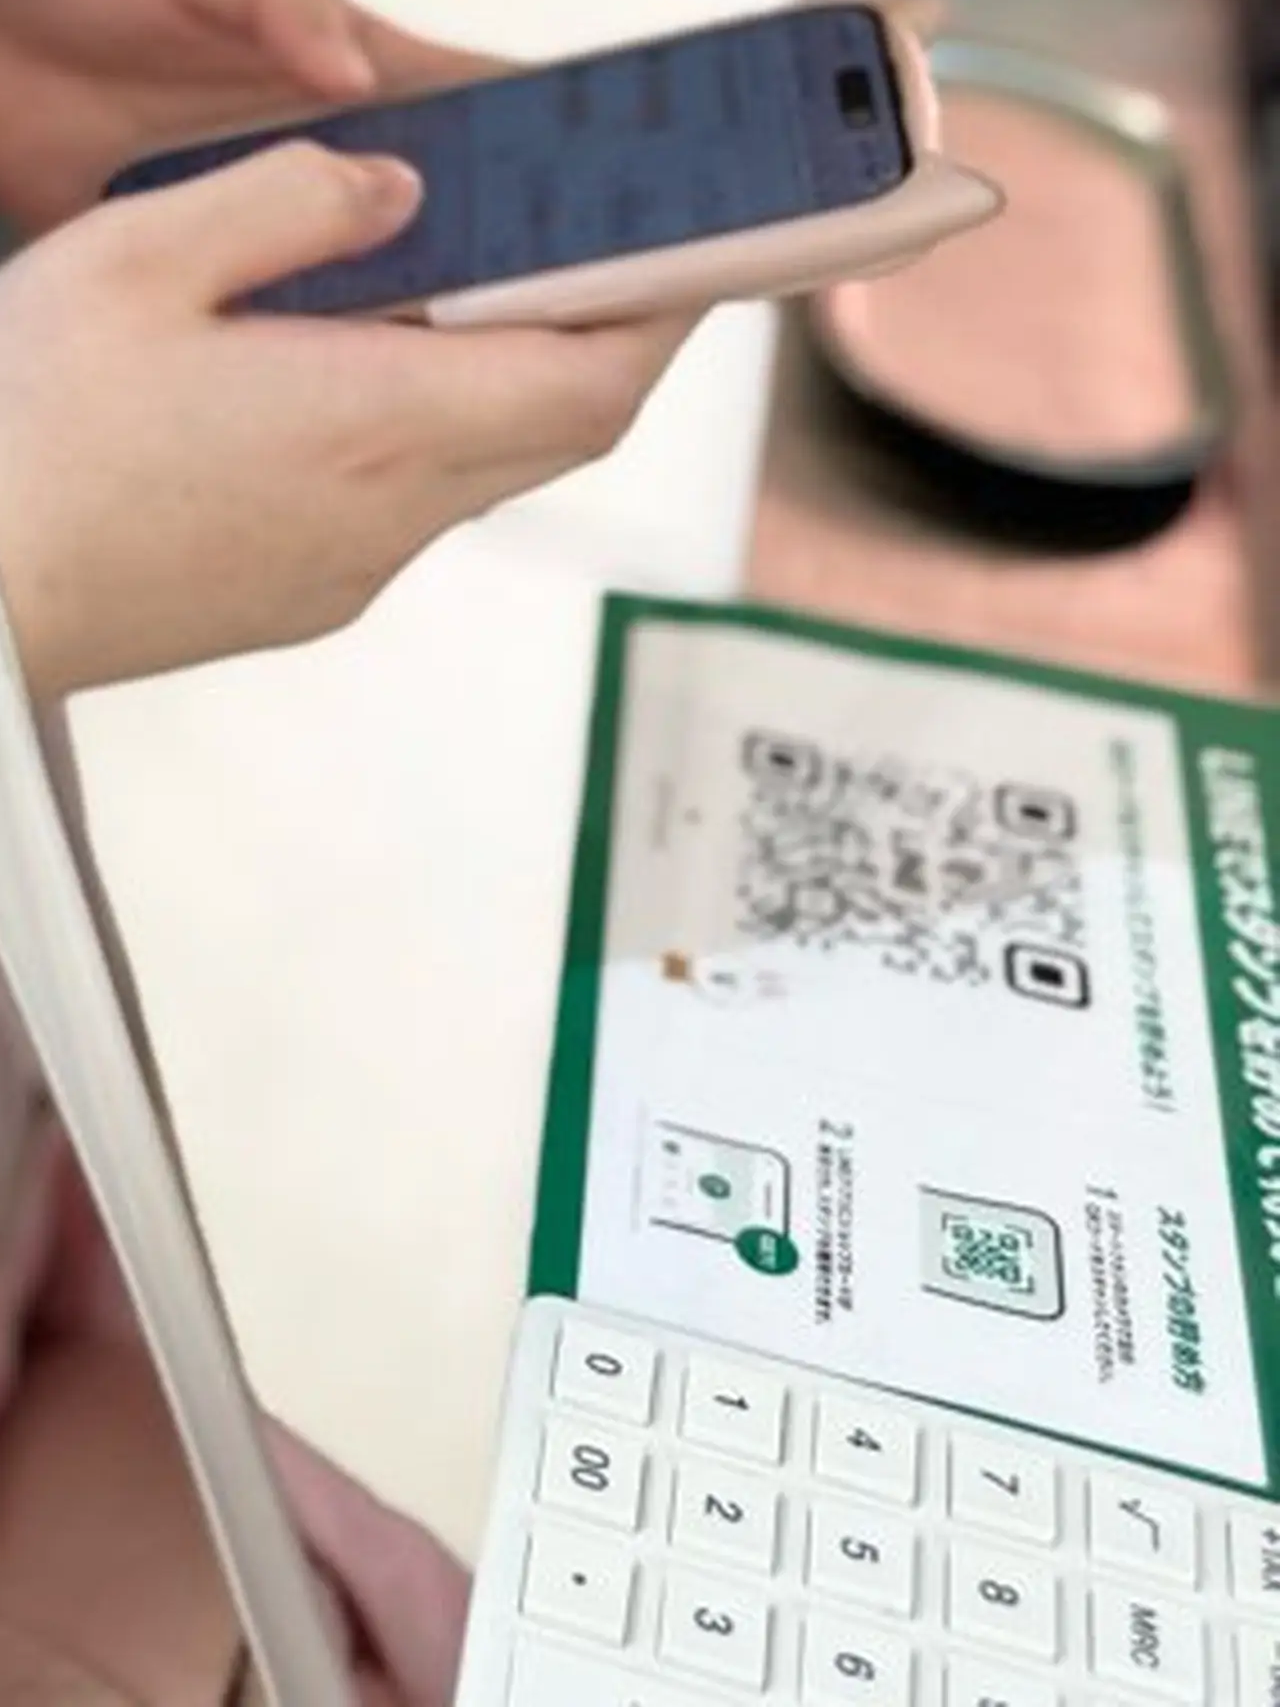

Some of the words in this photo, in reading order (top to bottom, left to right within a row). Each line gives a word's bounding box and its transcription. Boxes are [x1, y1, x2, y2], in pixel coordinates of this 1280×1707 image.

[585, 1352, 623, 1377] 0
[713, 1393, 750, 1412] 1
[846, 1428, 882, 1454] 4
[571, 1444, 611, 1493] 00
[981, 1467, 1021, 1497] 7
[705, 1494, 744, 1524] 2
[841, 1536, 880, 1565] 5
[978, 1579, 1020, 1608] 8
[693, 1606, 734, 1637] 3
[1130, 1602, 1161, 1670] MRC
[834, 1652, 875, 1682] 6
